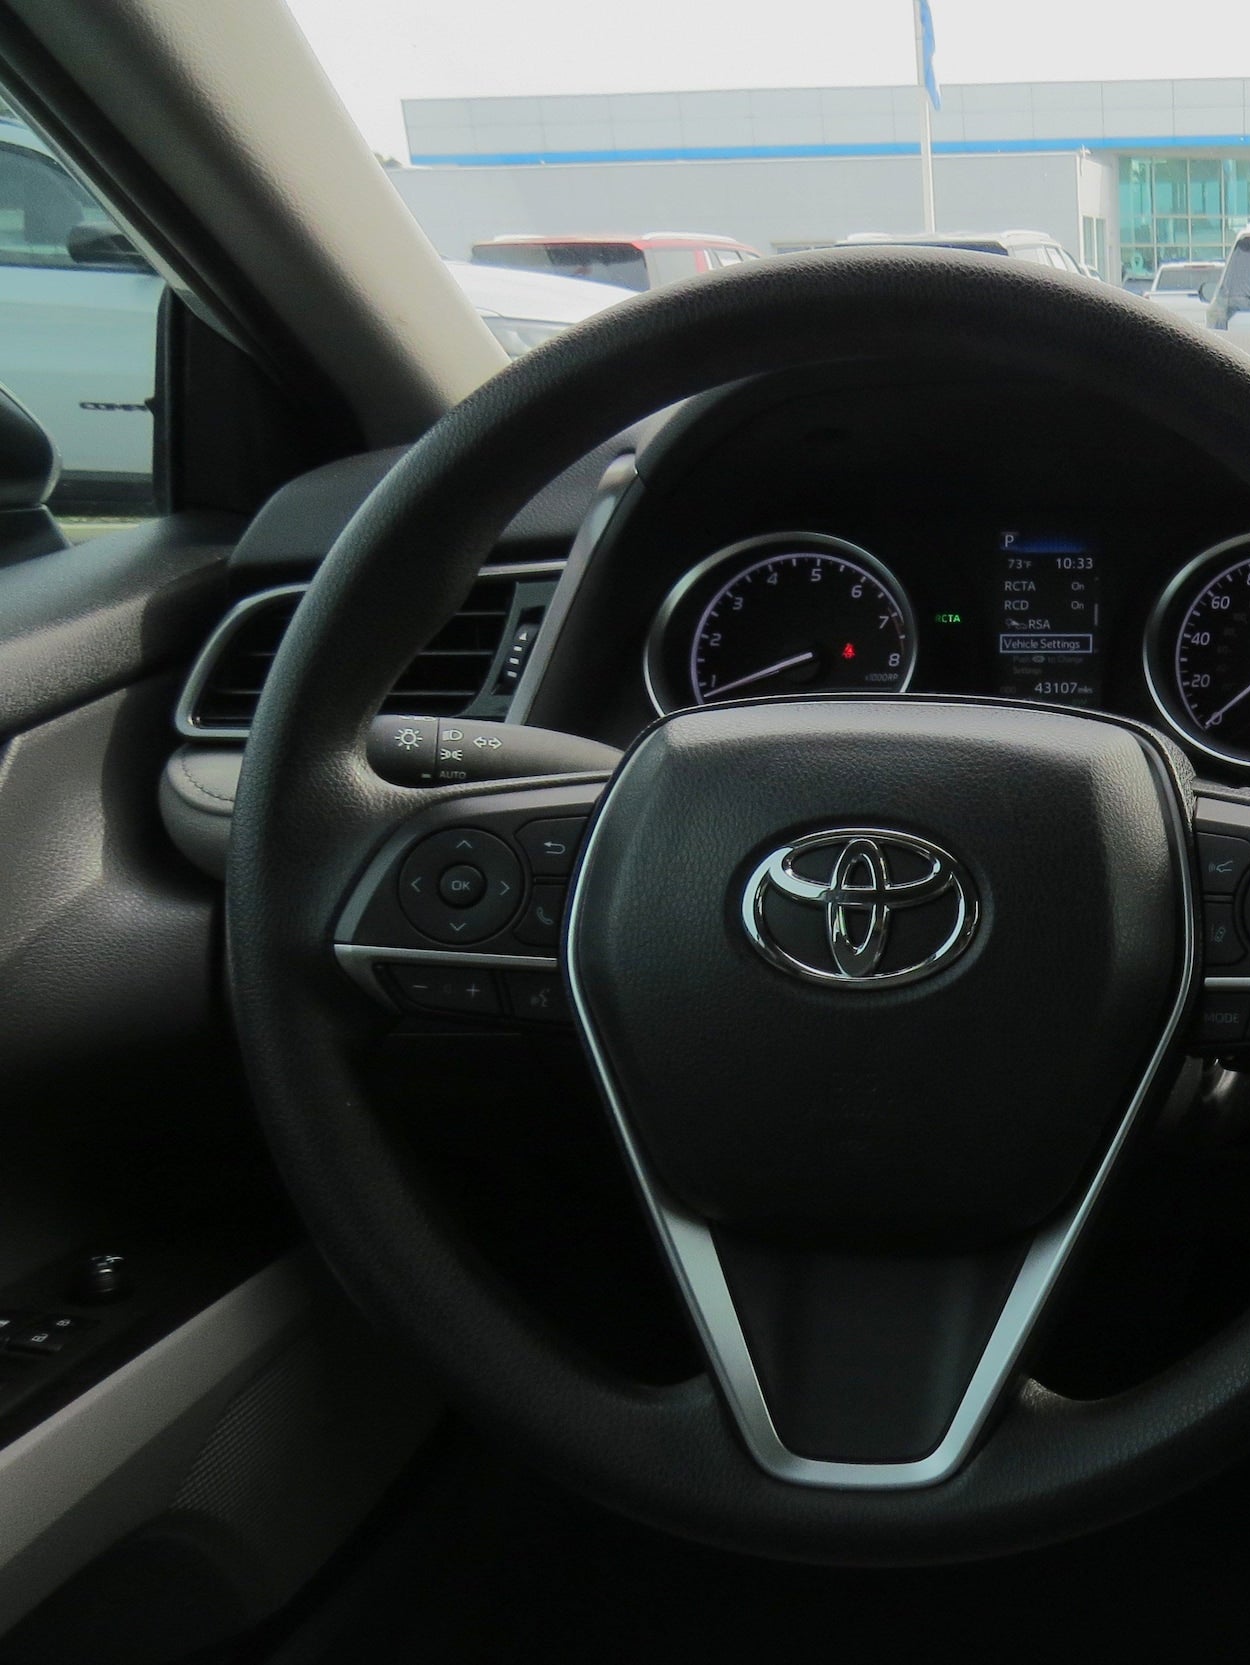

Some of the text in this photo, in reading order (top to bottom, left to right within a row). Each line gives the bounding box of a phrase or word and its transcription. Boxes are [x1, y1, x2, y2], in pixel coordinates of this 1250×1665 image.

[1004, 534, 1015, 548] P
[1056, 557, 1094, 570] 10:33
[767, 571, 778, 585] 4
[811, 568, 822, 582] 5
[851, 585, 862, 598] 6
[1004, 580, 1085, 592] RCTA On
[732, 597, 744, 610] 3
[1003, 600, 1085, 611] RCD On
[1211, 595, 1230, 610] 60
[879, 615, 889, 629] 7
[935, 613, 961, 623] RCTA
[1028, 619, 1051, 630] RSA
[710, 632, 722, 647] 2
[1003, 638, 1081, 651] Vehicle Settings
[1191, 631, 1210, 646] 40
[889, 652, 900, 667] 8
[711, 673, 717, 688] 1
[1191, 673, 1210, 688] 20
[1034, 682, 1079, 694] 43107
[440, 770, 467, 780] AUTO
[451, 880, 471, 891] OK
[1205, 1012, 1239, 1024] MODE
